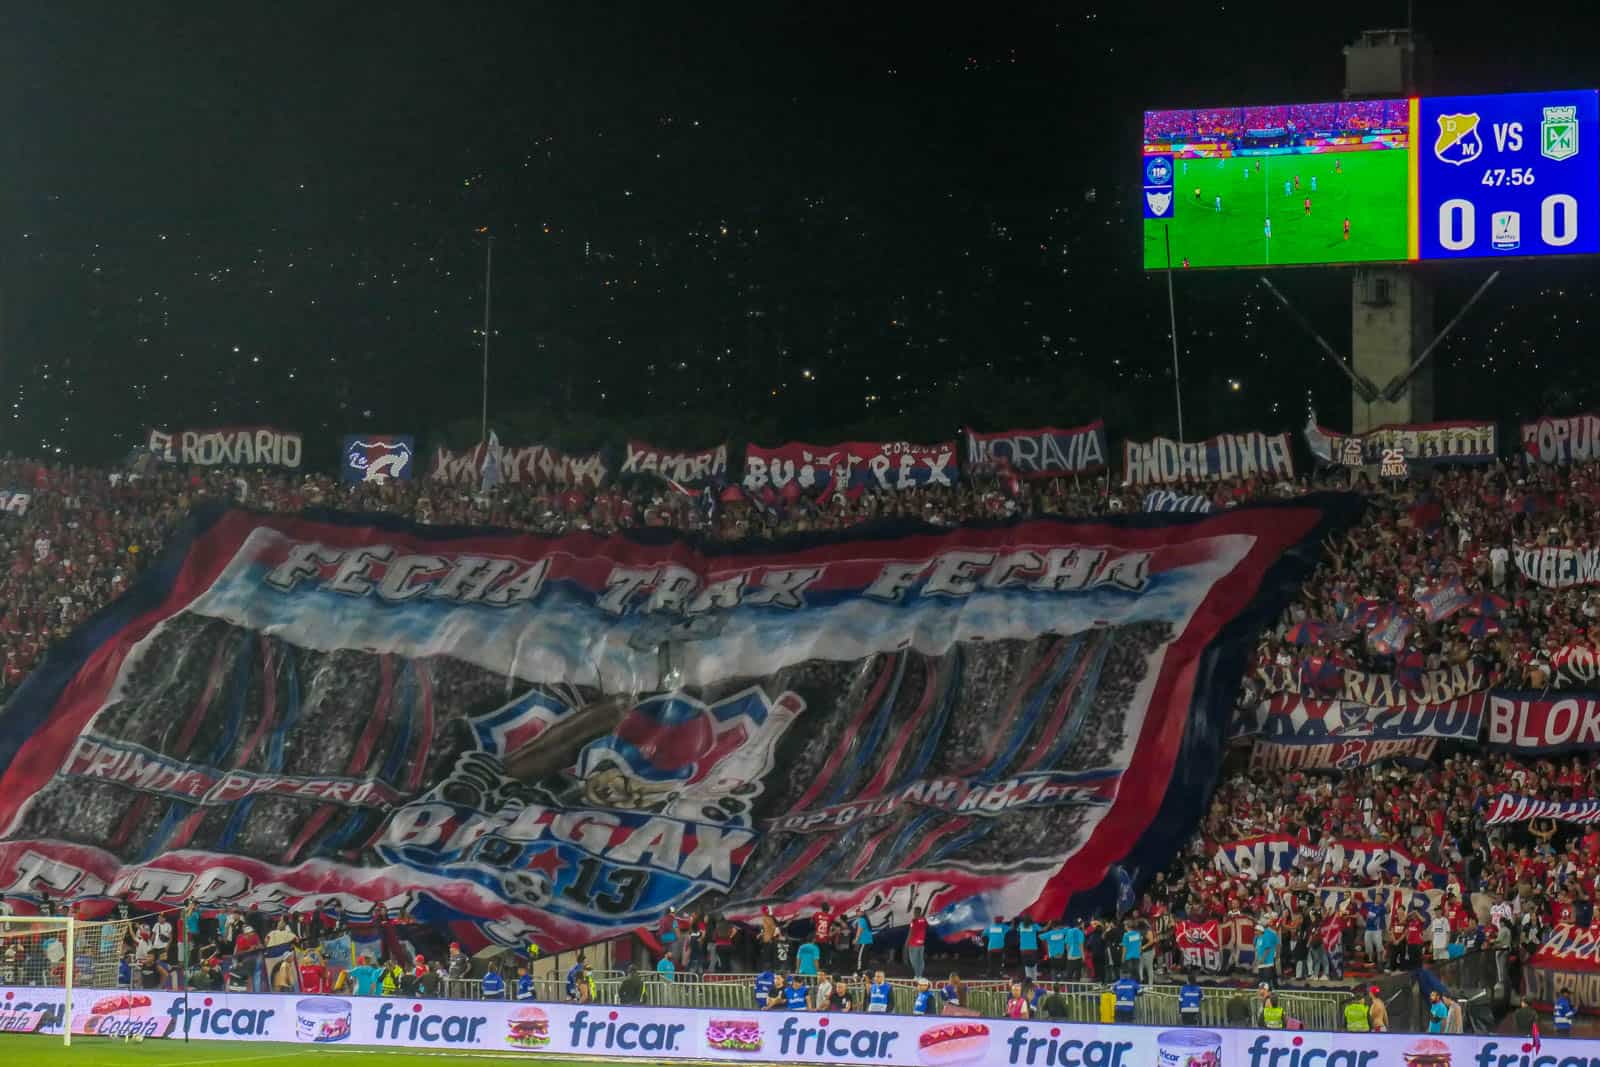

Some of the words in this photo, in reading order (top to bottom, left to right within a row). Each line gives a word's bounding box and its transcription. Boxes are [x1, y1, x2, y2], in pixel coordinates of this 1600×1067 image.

[1493, 122, 1523, 152] VS
[1481, 168, 1535, 186] 47:56
[1439, 198, 1475, 250] 0
[1541, 194, 1578, 246] 0
[182, 430, 302, 467] ROXARIO
[1382, 448, 1404, 463] 25
[264, 543, 553, 608] FECHA
[862, 548, 1153, 600] FECHA
[565, 857, 651, 914] 13
